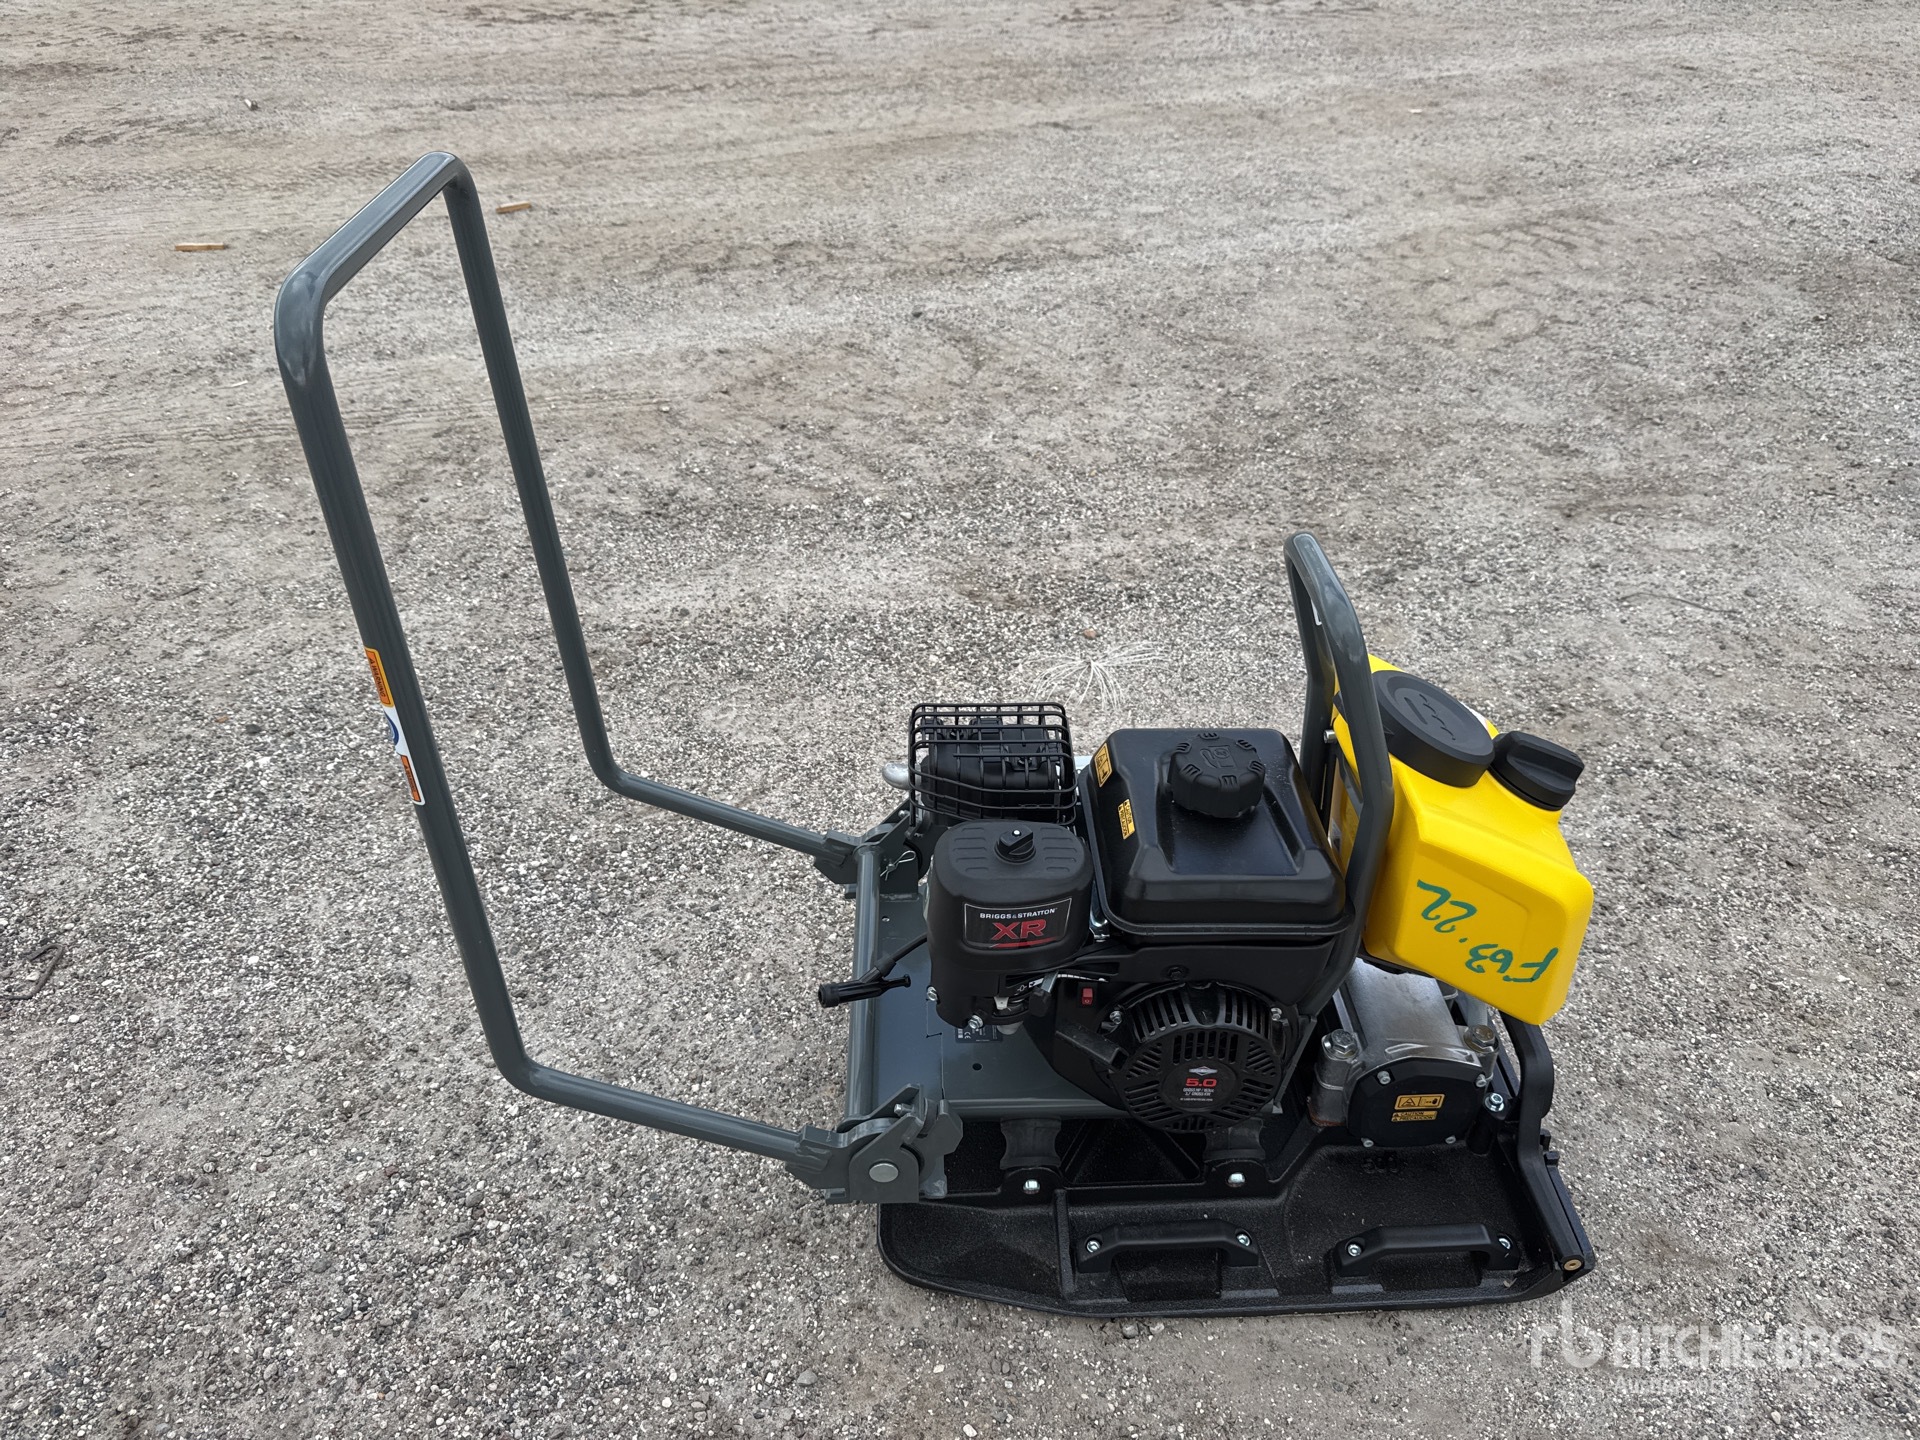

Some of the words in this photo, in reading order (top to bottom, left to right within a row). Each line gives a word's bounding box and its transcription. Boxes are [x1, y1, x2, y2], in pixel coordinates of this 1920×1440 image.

[371, 665, 386, 698] WARNING
[990, 919, 1047, 940] XR
[1186, 1078, 1217, 1087] 5.0
